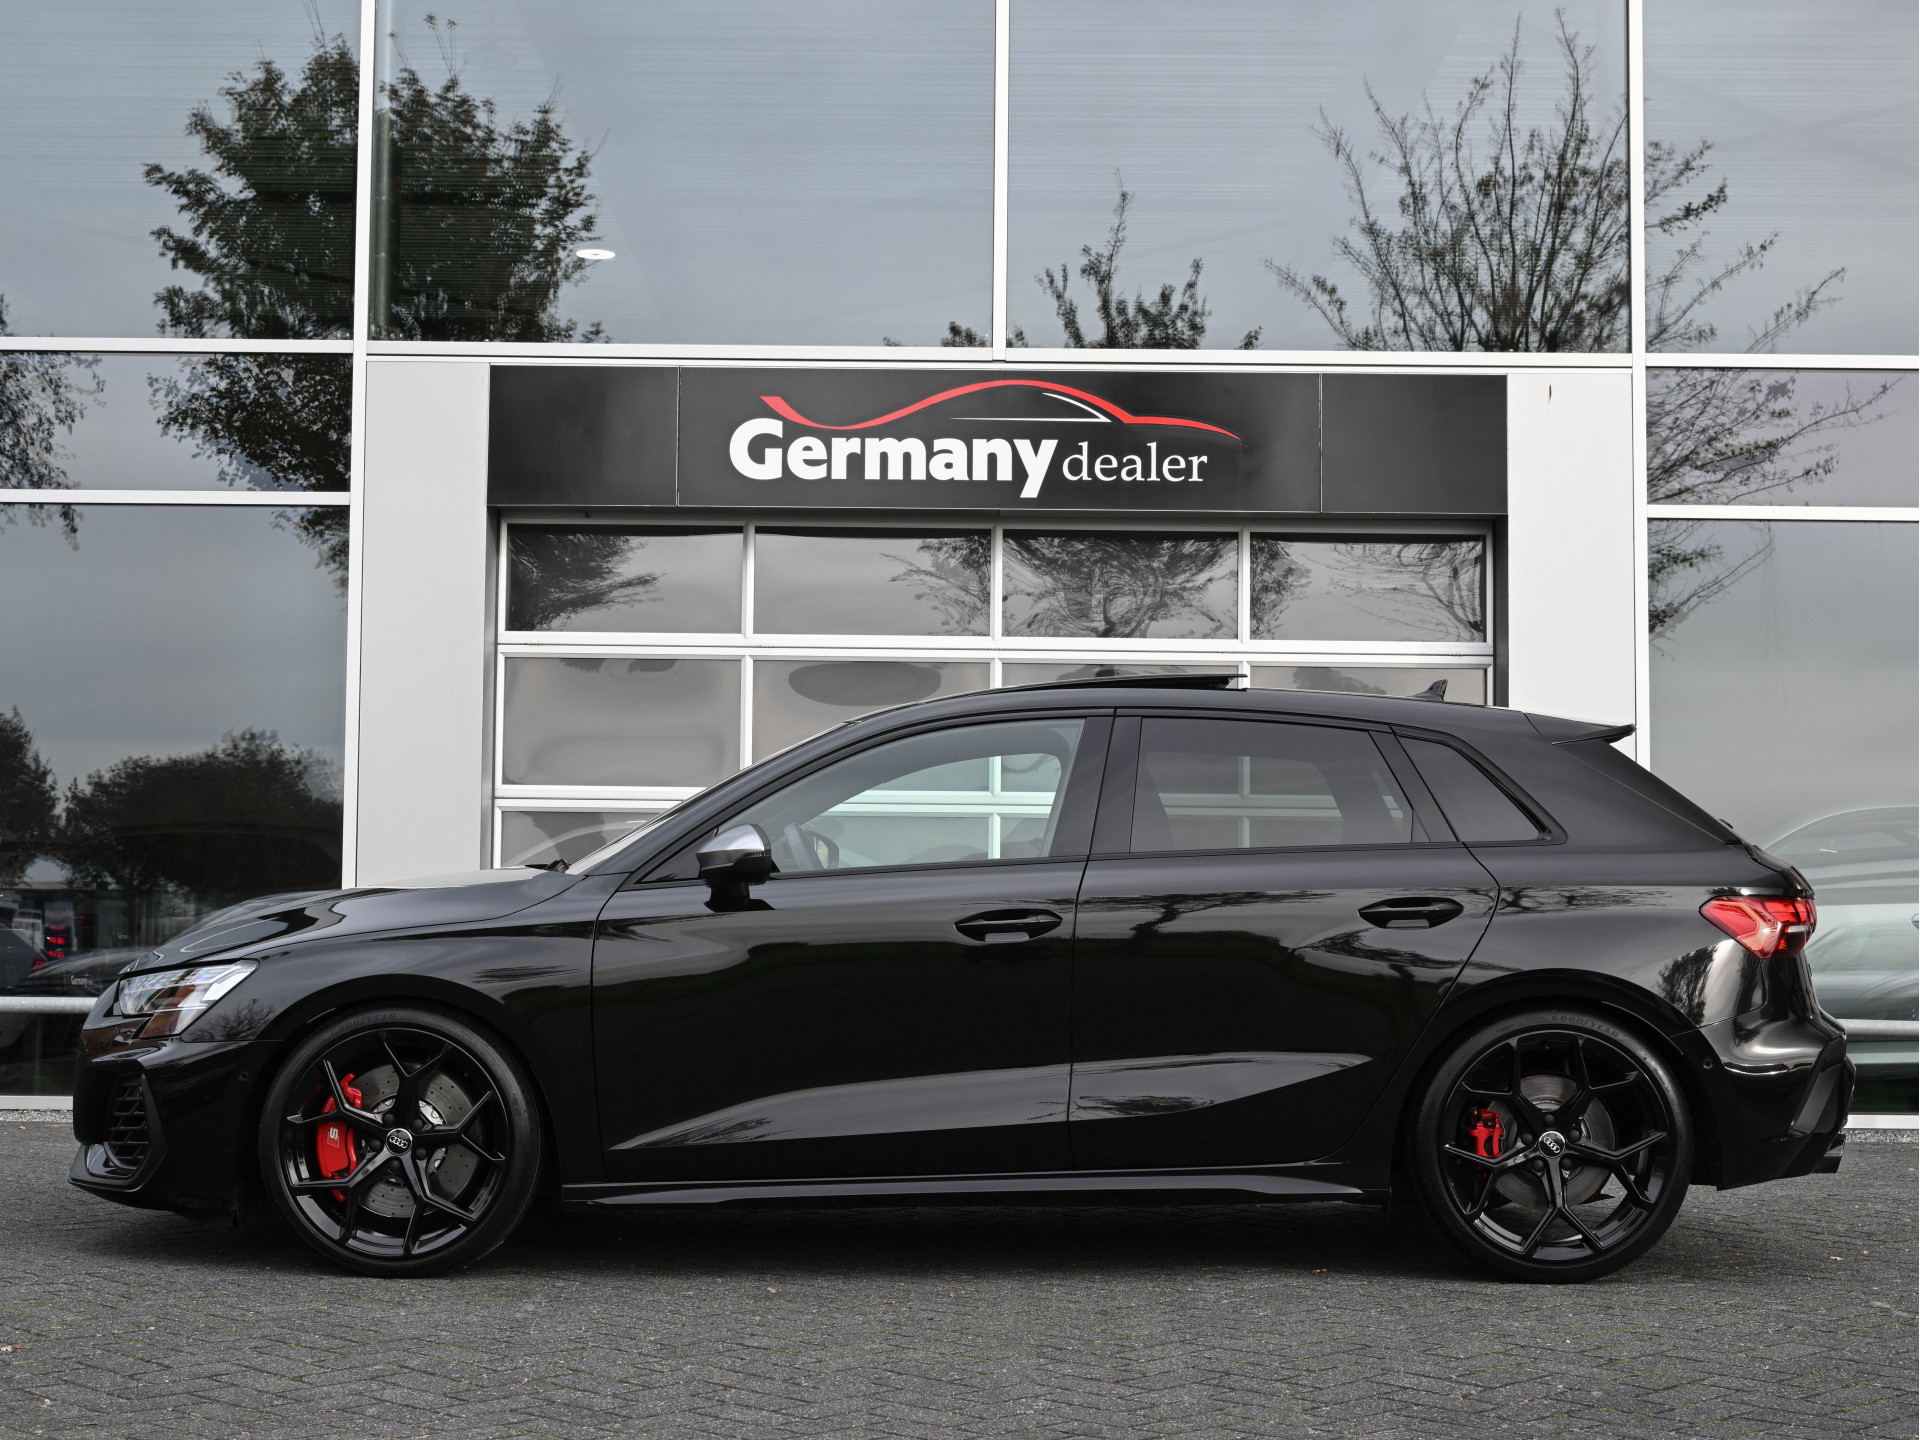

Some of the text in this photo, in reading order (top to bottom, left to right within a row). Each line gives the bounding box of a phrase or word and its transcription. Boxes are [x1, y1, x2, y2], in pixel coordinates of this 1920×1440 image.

[729, 418, 1208, 498] Germany dealer
[1551, 1015, 1620, 1037] GOODYEAR
[330, 1127, 339, 1140] S
